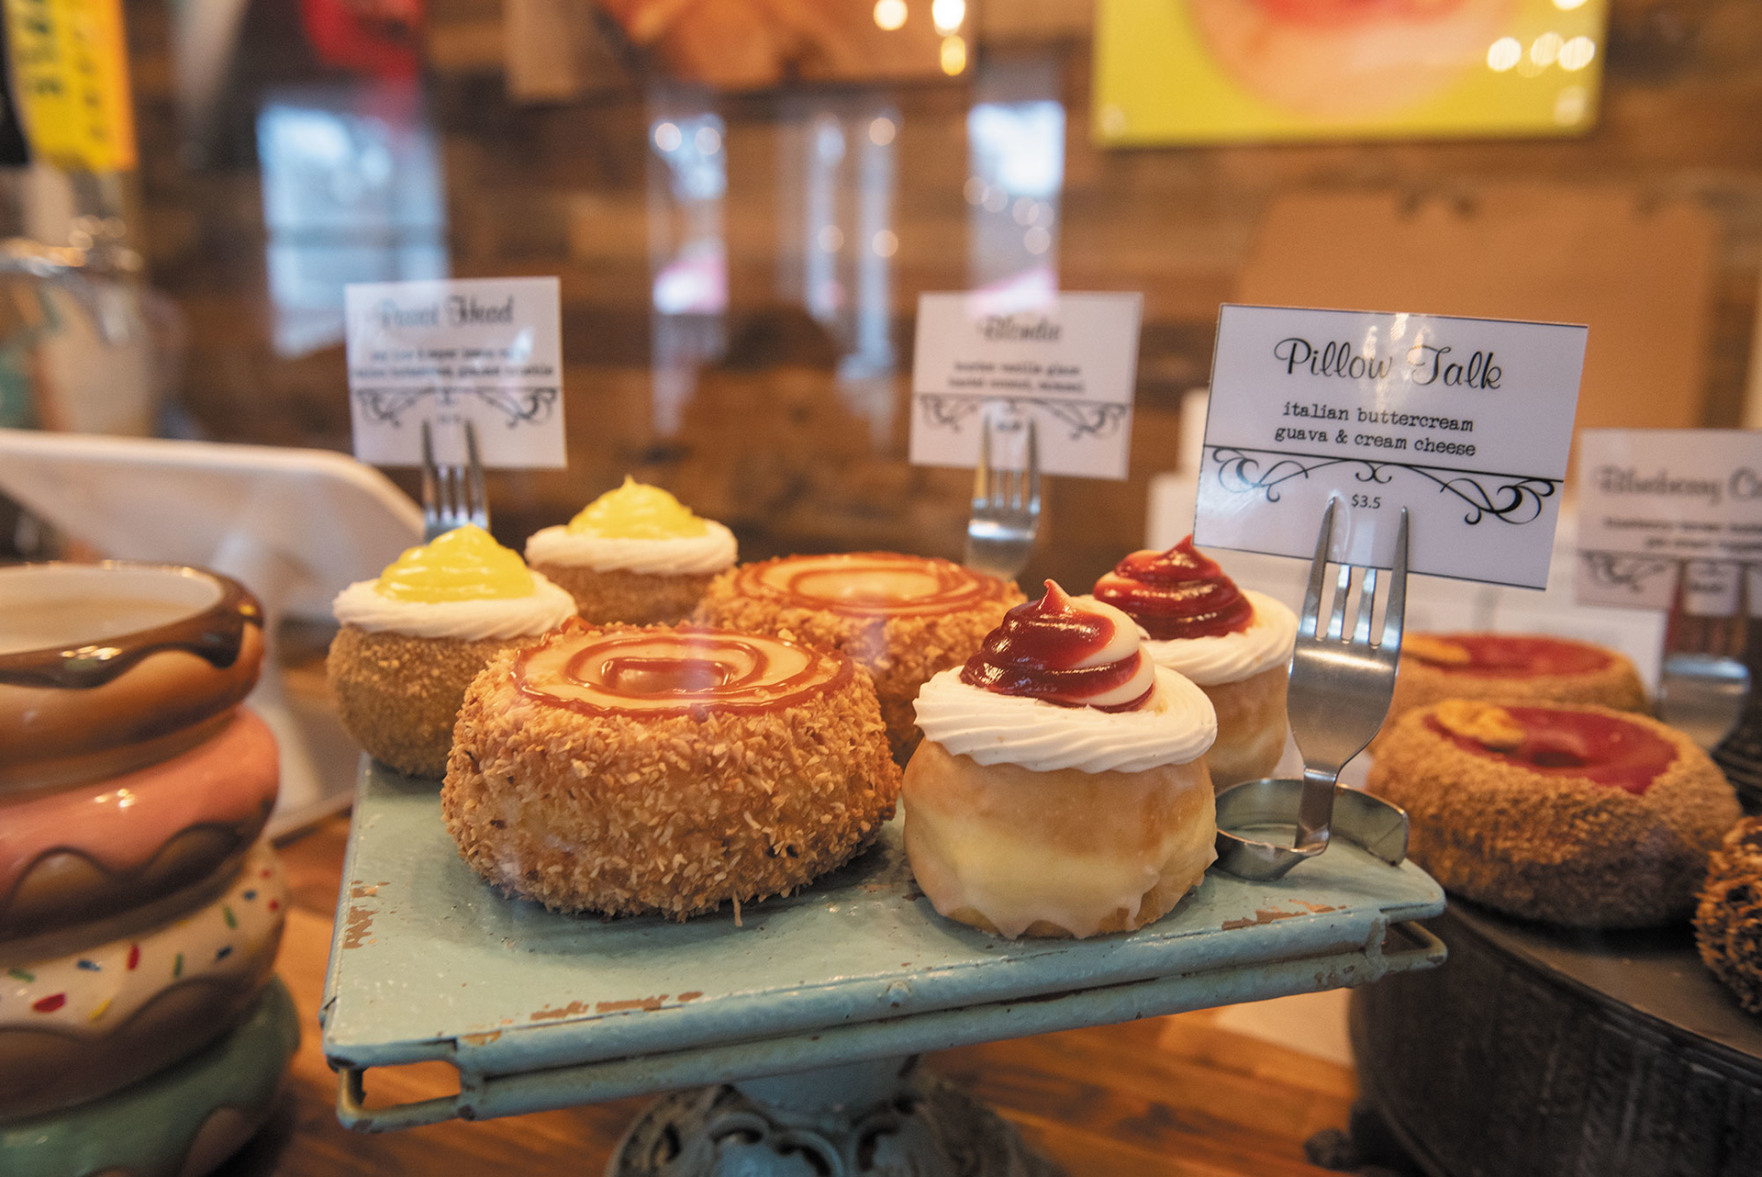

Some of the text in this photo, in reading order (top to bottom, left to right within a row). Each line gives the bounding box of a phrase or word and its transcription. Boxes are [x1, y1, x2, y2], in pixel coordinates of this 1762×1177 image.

[1273, 337, 1503, 390] Pillow Talk
[1282, 401, 1475, 433] italian buttercream
[1274, 427, 1478, 457] guava & cream cheese
[1350, 493, 1382, 510] $3.5
